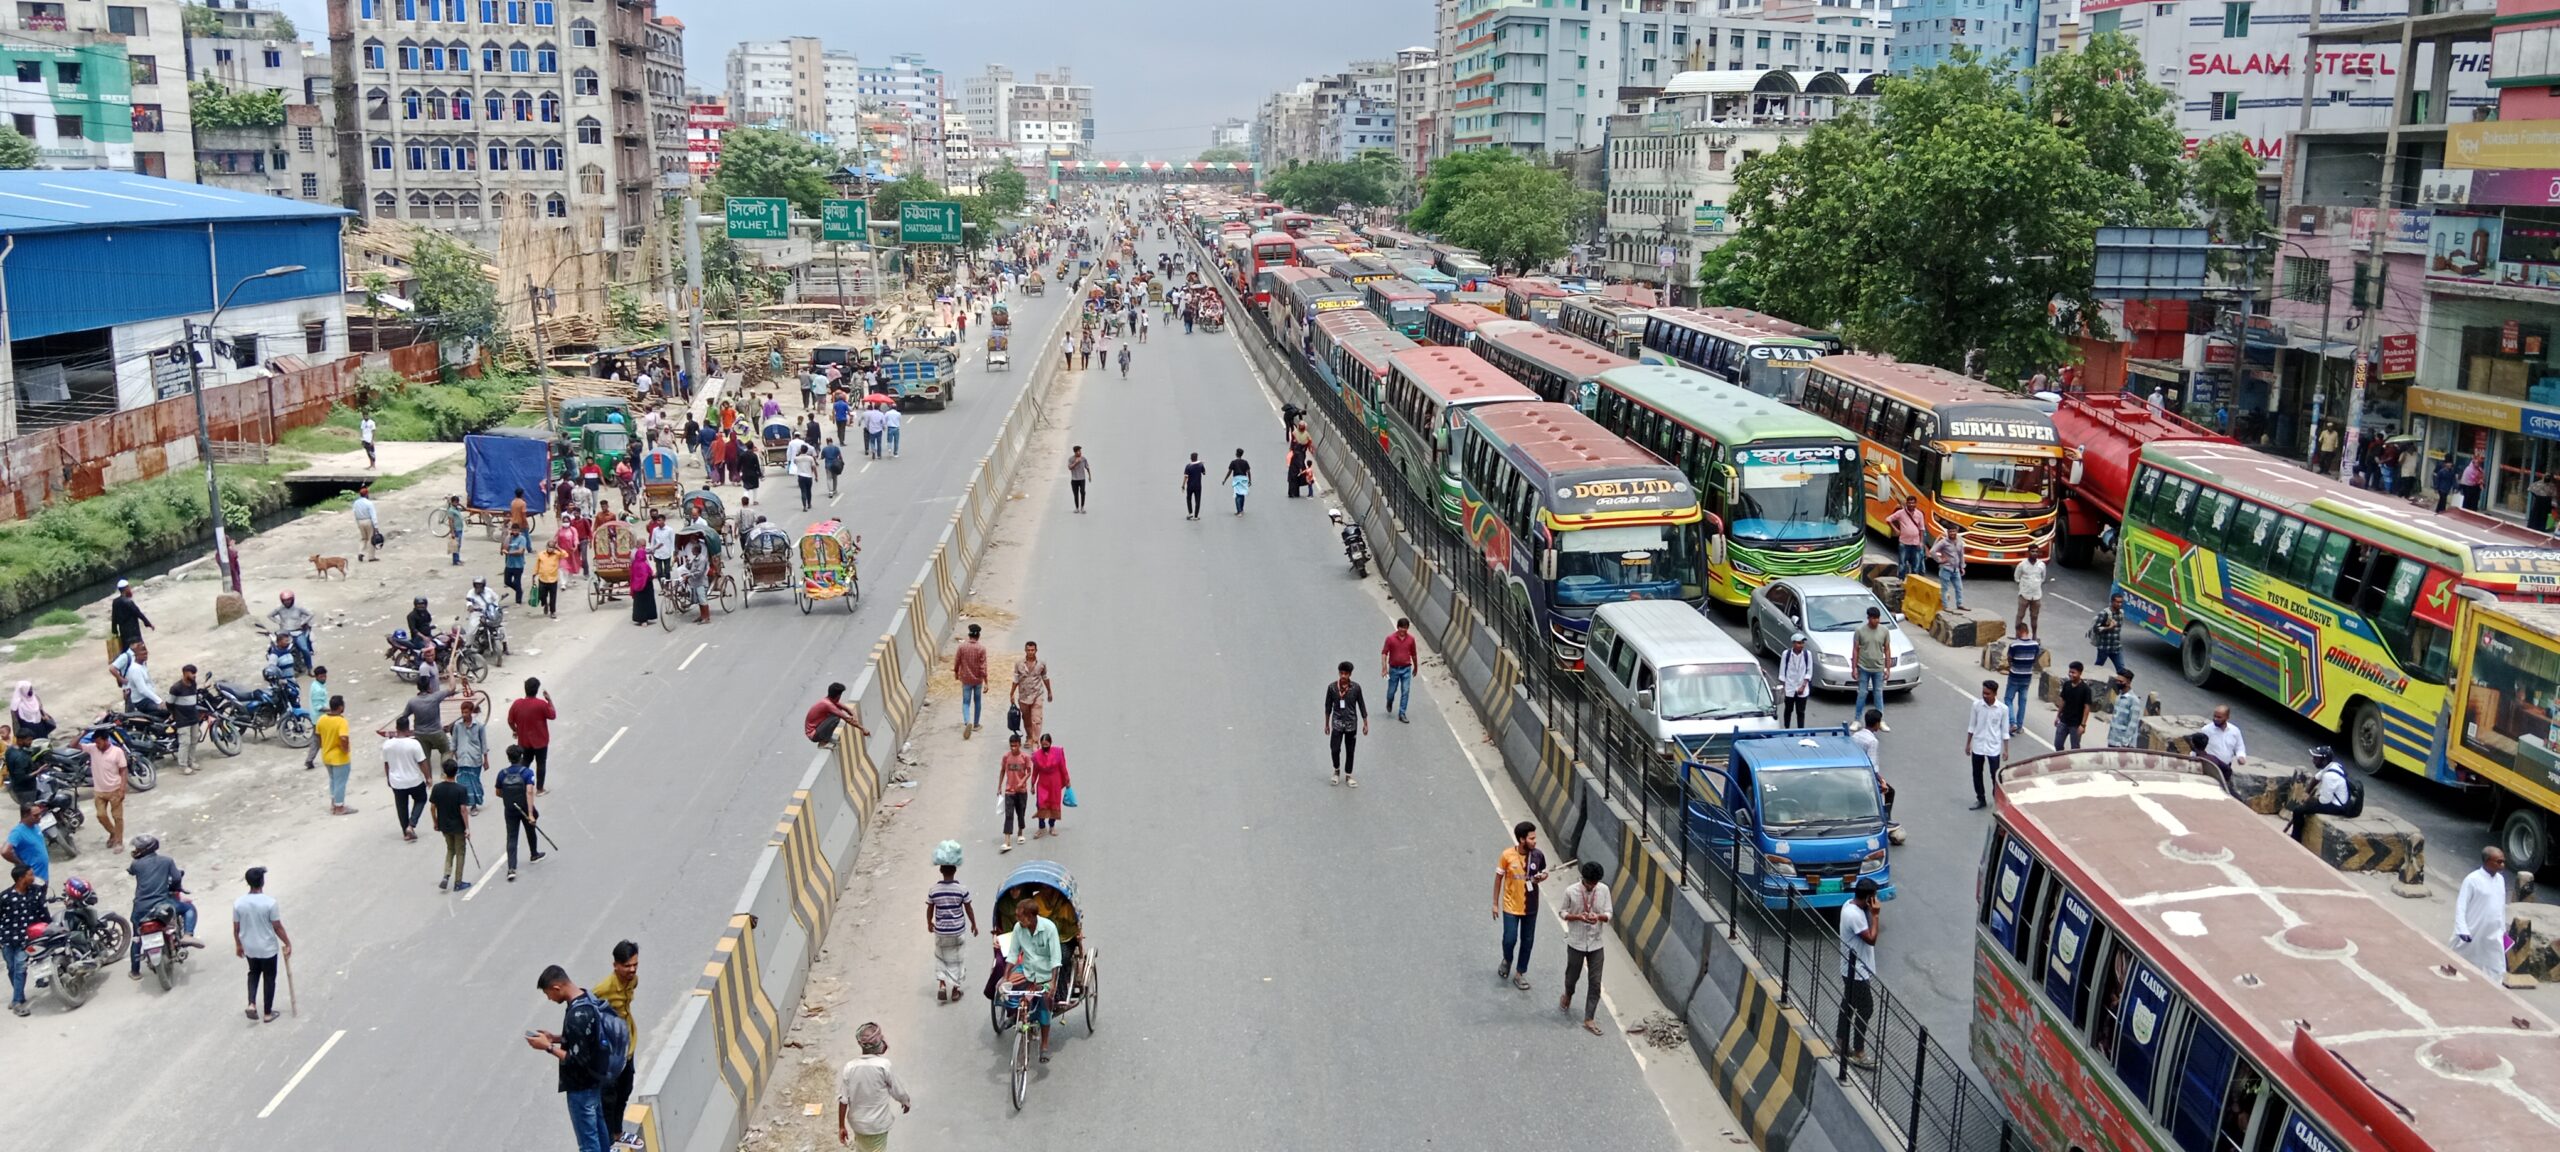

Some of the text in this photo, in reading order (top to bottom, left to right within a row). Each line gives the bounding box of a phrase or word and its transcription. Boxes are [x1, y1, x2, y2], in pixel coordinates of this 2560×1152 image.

[2188, 53, 2395, 75] SALAM STEEL
[728, 200, 768, 216] সিলেট
[823, 202, 848, 220] কুমিল্লা
[903, 204, 941, 220] চট্টগ্রাম
[730, 220, 768, 230] SYLHET
[824, 222, 850, 231] CUMILLA
[904, 224, 942, 233] CHATTOGRAM
[1317, 301, 1340, 309] DOEL
[1951, 421, 2055, 442] SURMA SUPER
[1573, 480, 1676, 498] DOEL LTD.
[2520, 575, 2556, 585] AMIR
[2266, 591, 2289, 610] TISTA
[2290, 601, 2332, 628] EXCLUSIVE
[2324, 646, 2361, 674] AMIR
[2008, 840, 2029, 866] CLASSIC
[2065, 896, 2089, 926] CLASSIC
[2140, 969, 2168, 1003] CLASSIC
